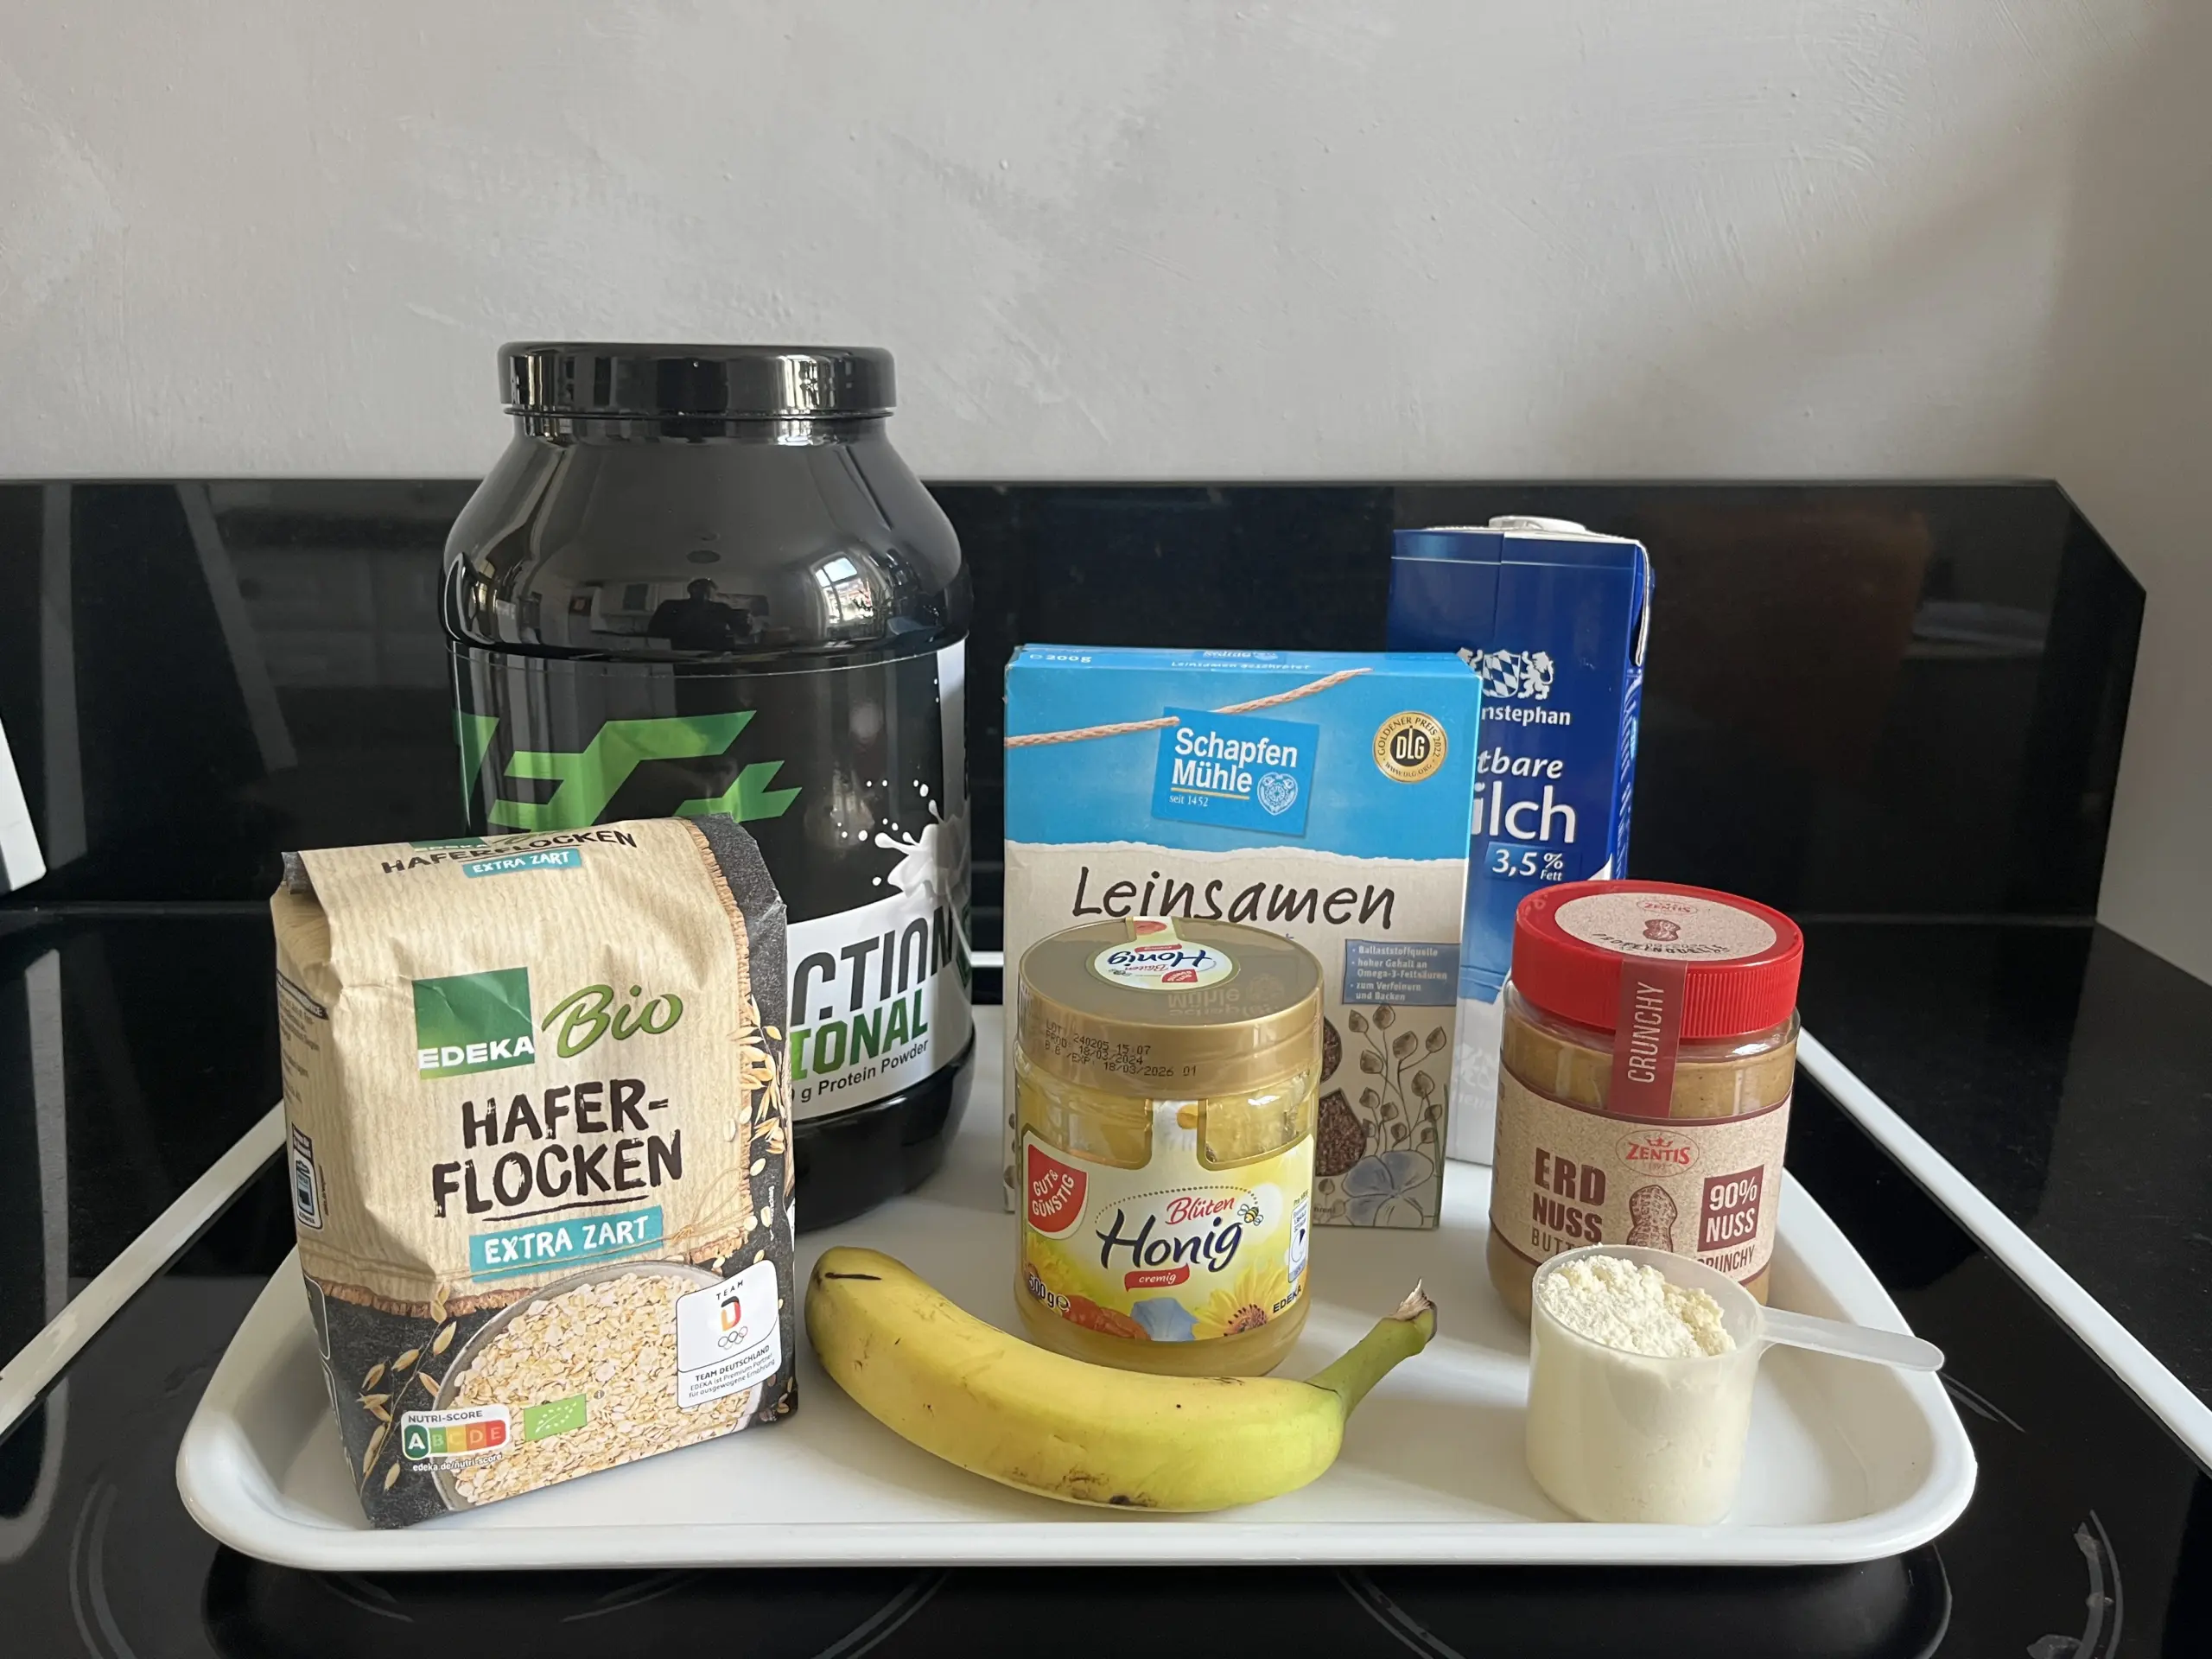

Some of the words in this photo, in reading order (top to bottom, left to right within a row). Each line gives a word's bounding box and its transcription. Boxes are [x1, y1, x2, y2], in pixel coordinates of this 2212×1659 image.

[1046, 654, 1092, 663] 200g
[1481, 705, 1571, 726] nstephan
[1175, 728, 1298, 768] Schapfen
[1377, 716, 1412, 756] GOLDENER
[1414, 716, 1438, 736] PREIS
[1433, 736, 1442, 758] 2022
[1395, 727, 1425, 760] DLG
[1172, 758, 1252, 792] Mühle
[1477, 747, 1563, 779] tbare
[1169, 794, 1184, 804] seit
[1187, 796, 1209, 807] 1452
[1471, 780, 1576, 843] ilch
[381, 830, 637, 874] HAFERFLOCKEN
[472, 857, 525, 874] EXTRA
[530, 850, 570, 865] ZART
[1540, 869, 1562, 881] Fett
[1072, 867, 1395, 929] Leinsamen
[1107, 949, 1213, 968] Honig
[1357, 957, 1383, 967] hoher
[1358, 945, 1438, 957] Ballaststoffquelle
[1376, 982, 1421, 991] Verfeinern
[541, 983, 683, 1058] Bio
[1628, 982, 1664, 1083] CRUNCHY
[418, 1036, 535, 1070] EDEKA
[1073, 1033, 1109, 1051] 240205
[1078, 1045, 1143, 1065] 18/03/2024
[801, 1087, 811, 1103] g
[818, 1067, 876, 1096] Protein
[881, 1039, 929, 1074] Powder
[1103, 1061, 1174, 1077] 18/03/2026
[462, 1078, 669, 1149] HAFER-
[1625, 1141, 1691, 1166] ZENTIS
[432, 1128, 682, 1218] FLOCKEN
[1535, 1147, 1606, 1206] ERD
[1032, 1173, 1075, 1217] GÜNSTIG
[1709, 1176, 1758, 1211] 90%
[1165, 1196, 1236, 1225] Blüten
[1532, 1192, 1603, 1243] NUSS
[1706, 1207, 1755, 1243] NUSS
[484, 1228, 573, 1265] EXTRA
[582, 1215, 649, 1250] ZART
[1096, 1208, 1244, 1273] Honig
[1532, 1228, 1580, 1255] BUTT
[715, 1280, 744, 1300] TEAM
[1139, 1272, 1177, 1284] cremig
[1273, 1285, 1301, 1313] EDEKA
[689, 1389, 699, 1398] für
[700, 1376, 746, 1395] ausgewogene
[747, 1359, 775, 1379] Ernährung
[690, 1379, 713, 1391] EDEKA
[723, 1365, 752, 1382] Premium
[753, 1353, 773, 1368] Partner
[695, 1369, 717, 1382] TEAM
[719, 1344, 770, 1375] DEUTSCHLAND
[408, 1410, 482, 1423] NUTRI-SCORE
[408, 1433, 425, 1450] A
[470, 1429, 484, 1444] D
[490, 1427, 502, 1440] E
[412, 1452, 503, 1471] edeka.de/nutri-score
